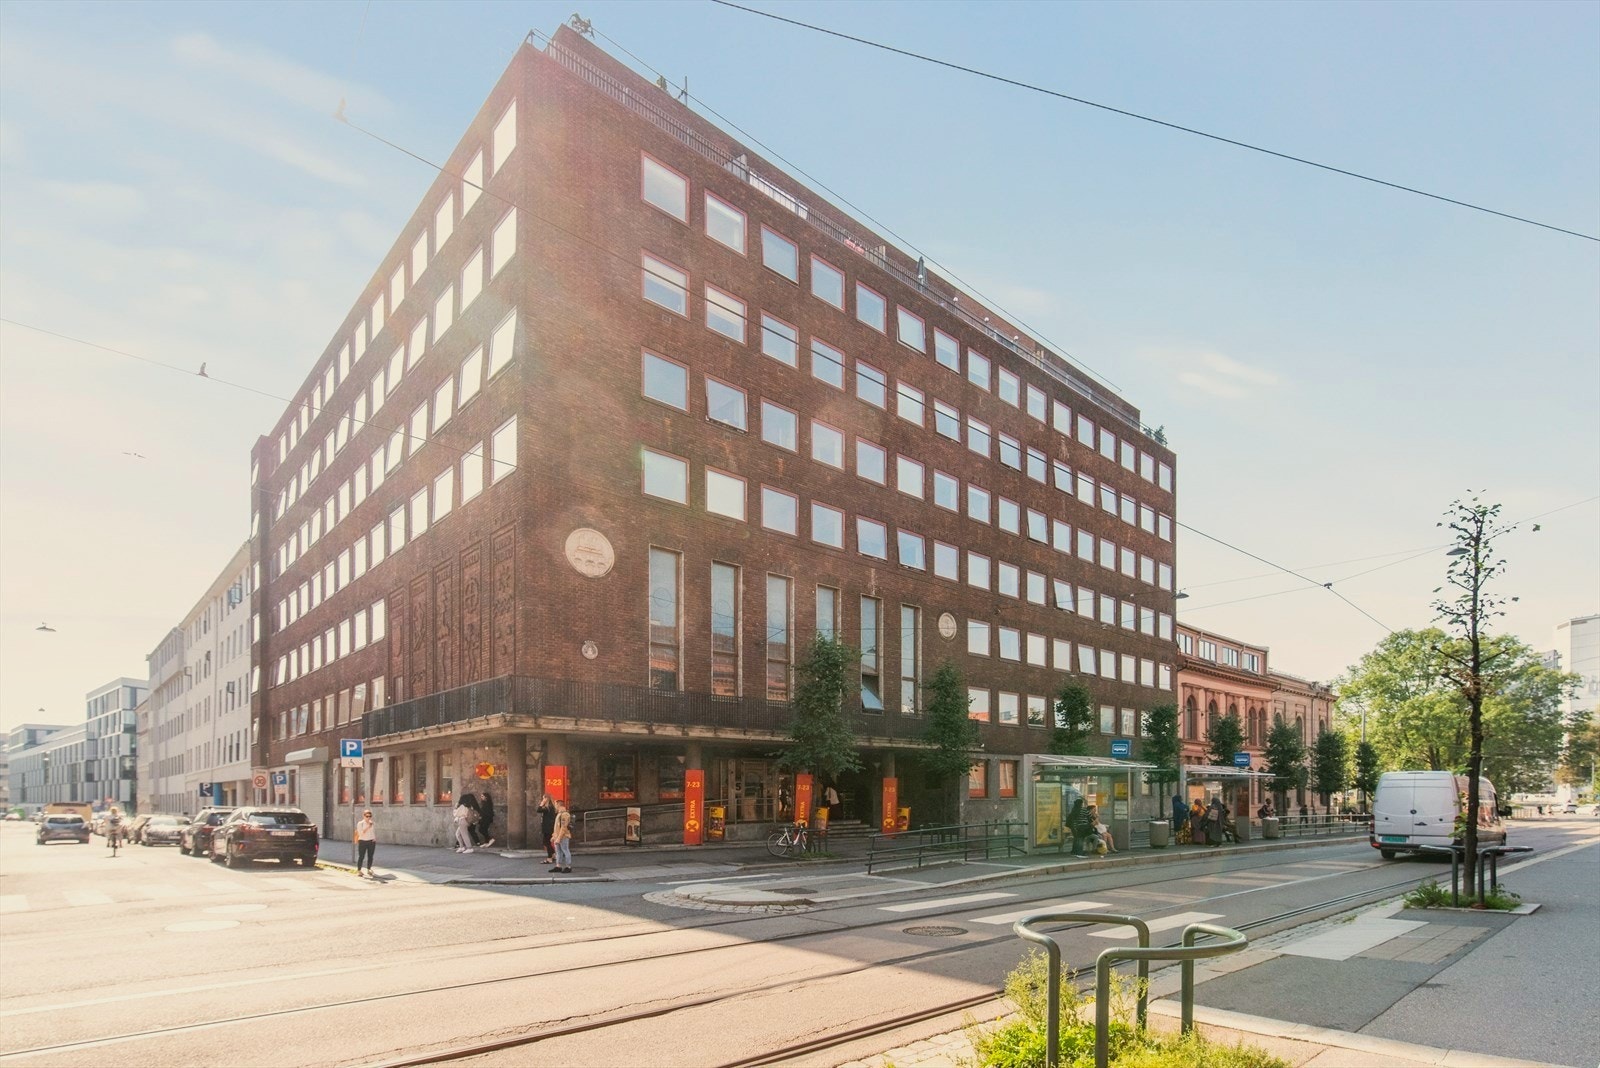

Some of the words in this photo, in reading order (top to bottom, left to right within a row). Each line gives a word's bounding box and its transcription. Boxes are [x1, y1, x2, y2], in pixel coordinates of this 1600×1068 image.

[345, 741, 357, 755] P
[276, 775, 284, 784] P
[203, 782, 211, 790] P
